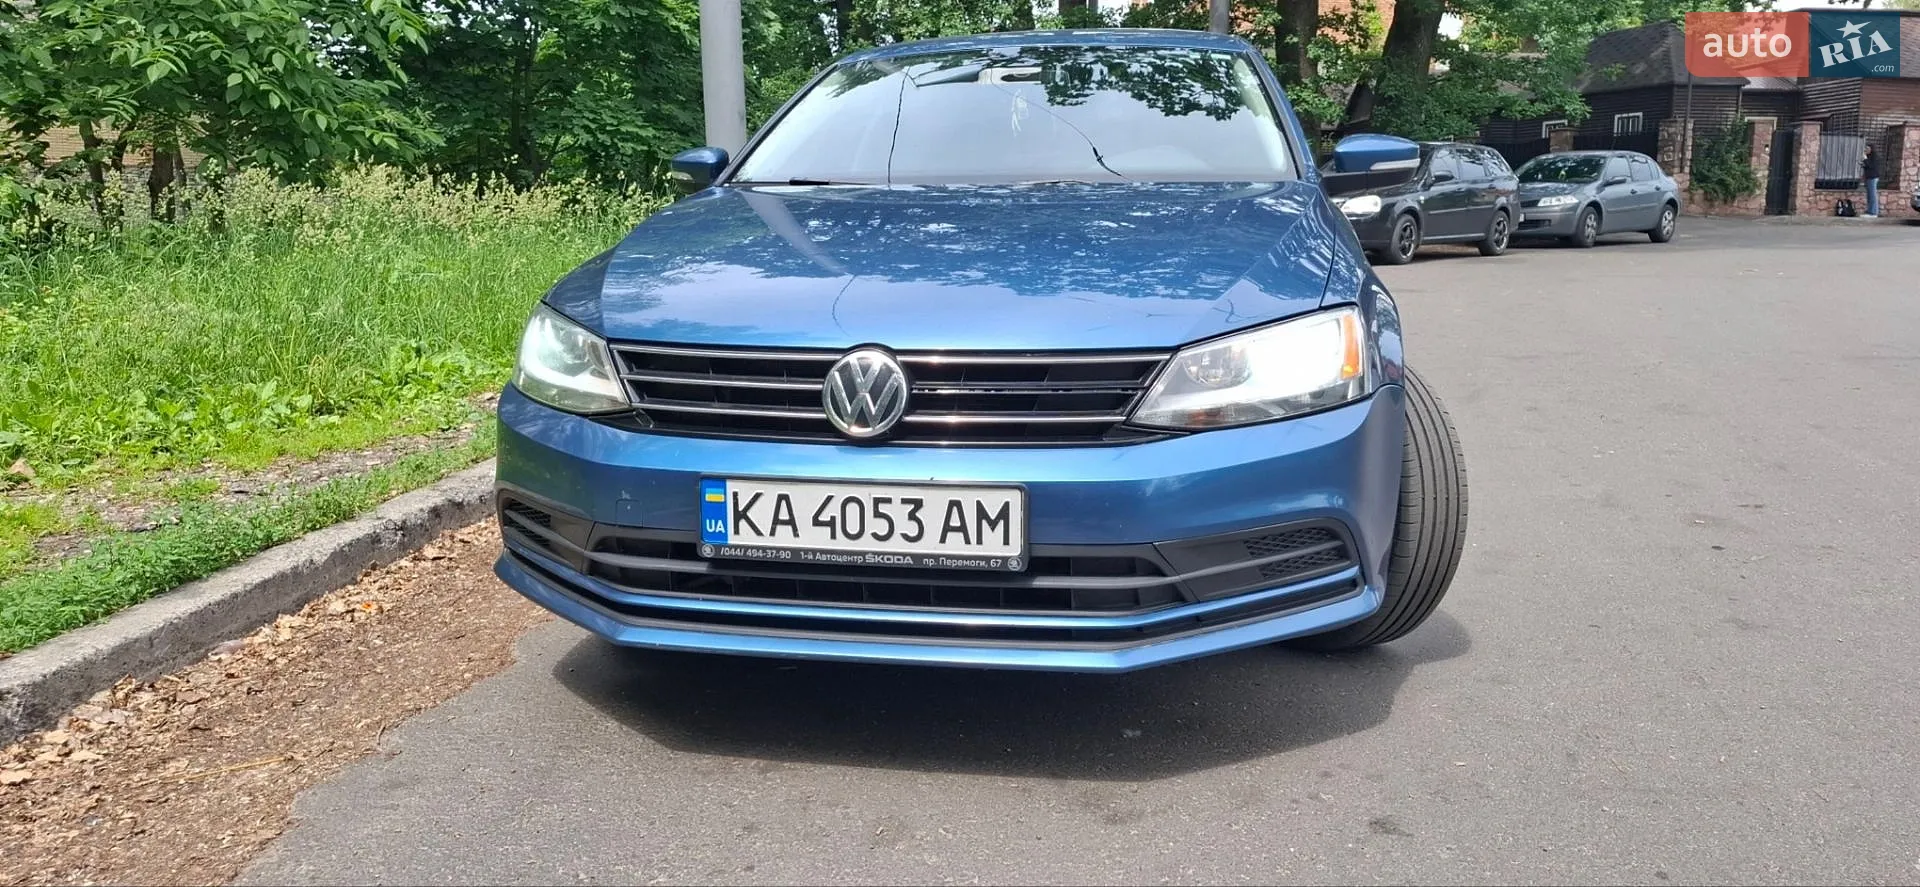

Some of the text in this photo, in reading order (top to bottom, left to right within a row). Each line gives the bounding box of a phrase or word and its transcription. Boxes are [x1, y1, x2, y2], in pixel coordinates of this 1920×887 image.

[706, 519, 726, 534] UA
[731, 490, 1011, 546] KA 4053 AM
[746, 548, 792, 559] 494-37-90
[800, 551, 813, 561] 1-й
[815, 552, 864, 564] Автоцентр
[990, 559, 1002, 568] 67
